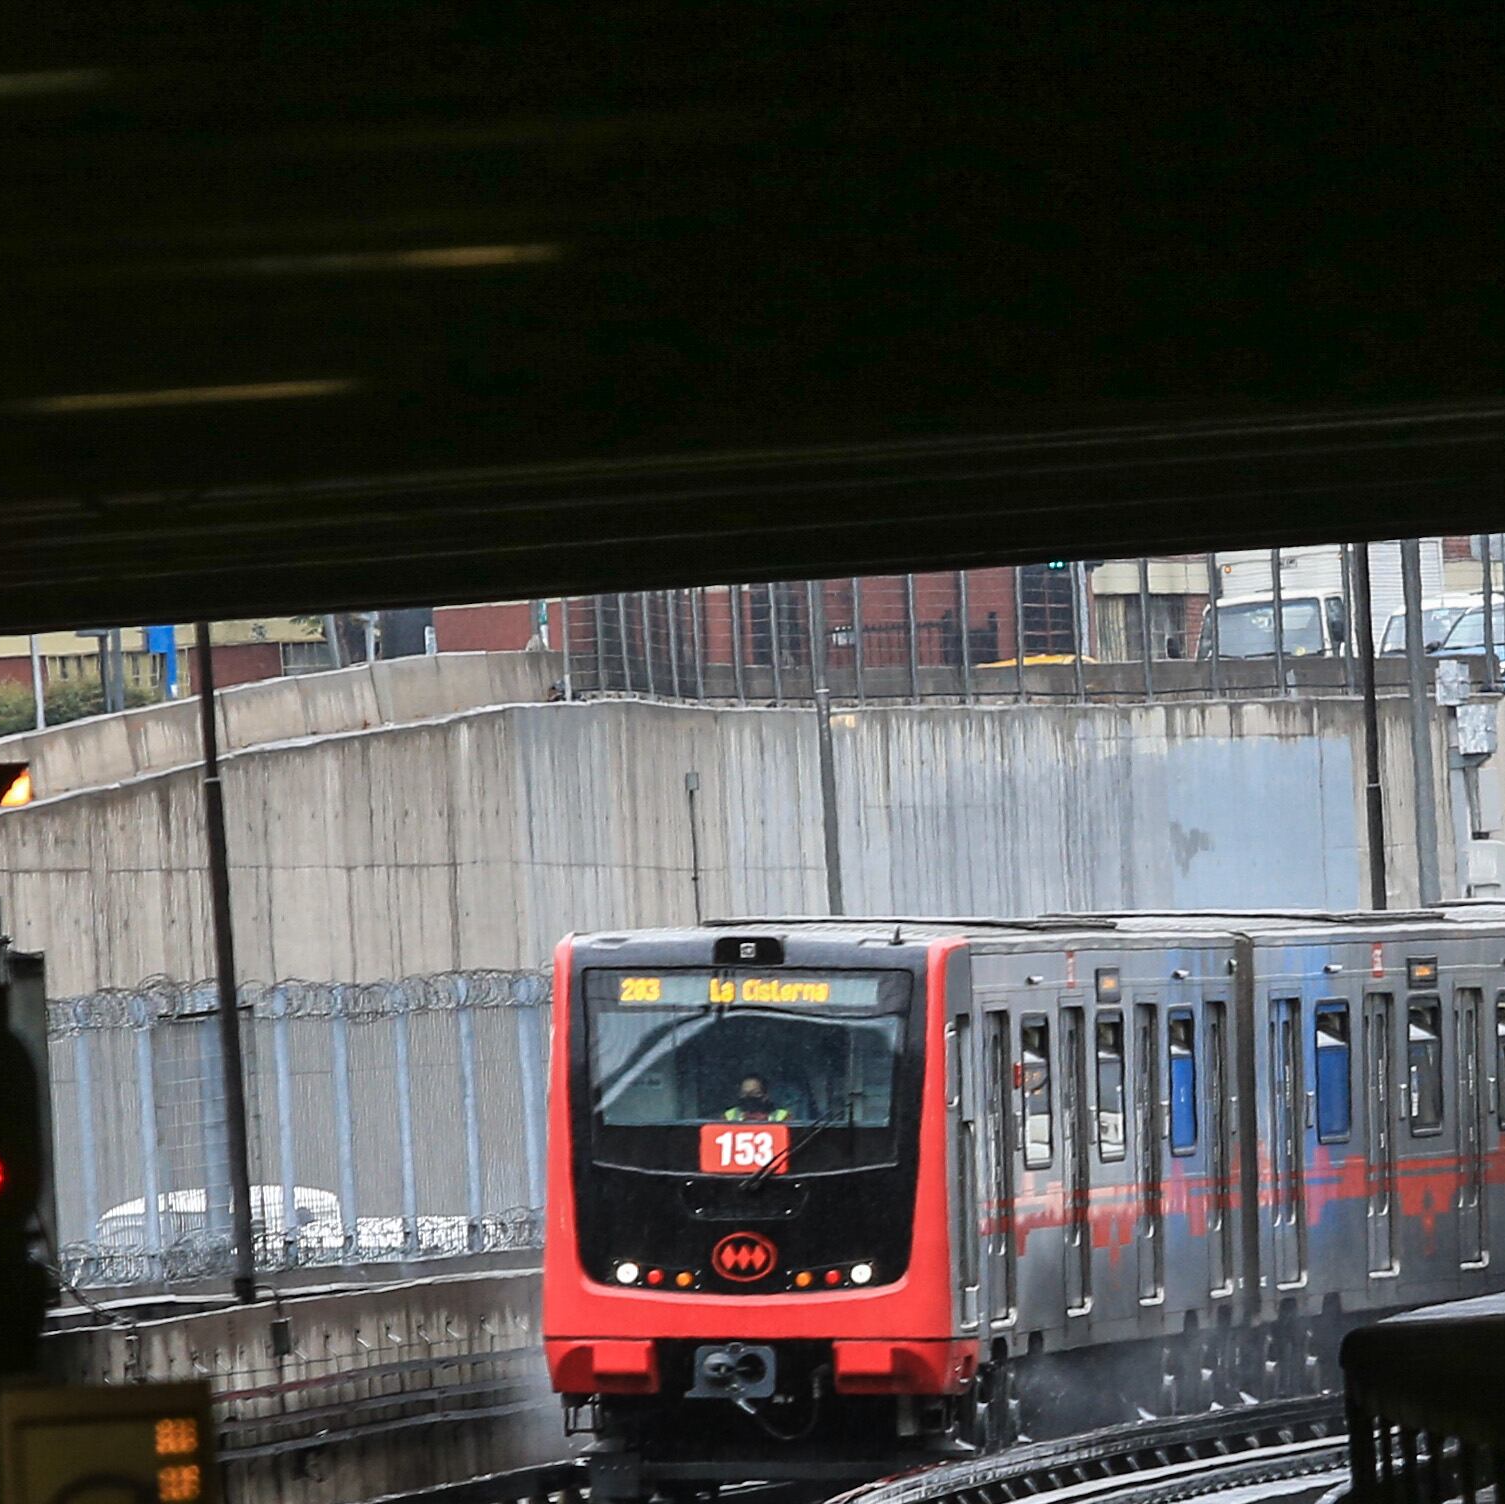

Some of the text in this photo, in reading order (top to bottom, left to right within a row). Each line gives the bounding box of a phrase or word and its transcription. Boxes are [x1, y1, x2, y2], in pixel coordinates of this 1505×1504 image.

[709, 977, 736, 1003] La
[742, 978, 830, 1003] Cisterna
[715, 1130, 774, 1168] 153
